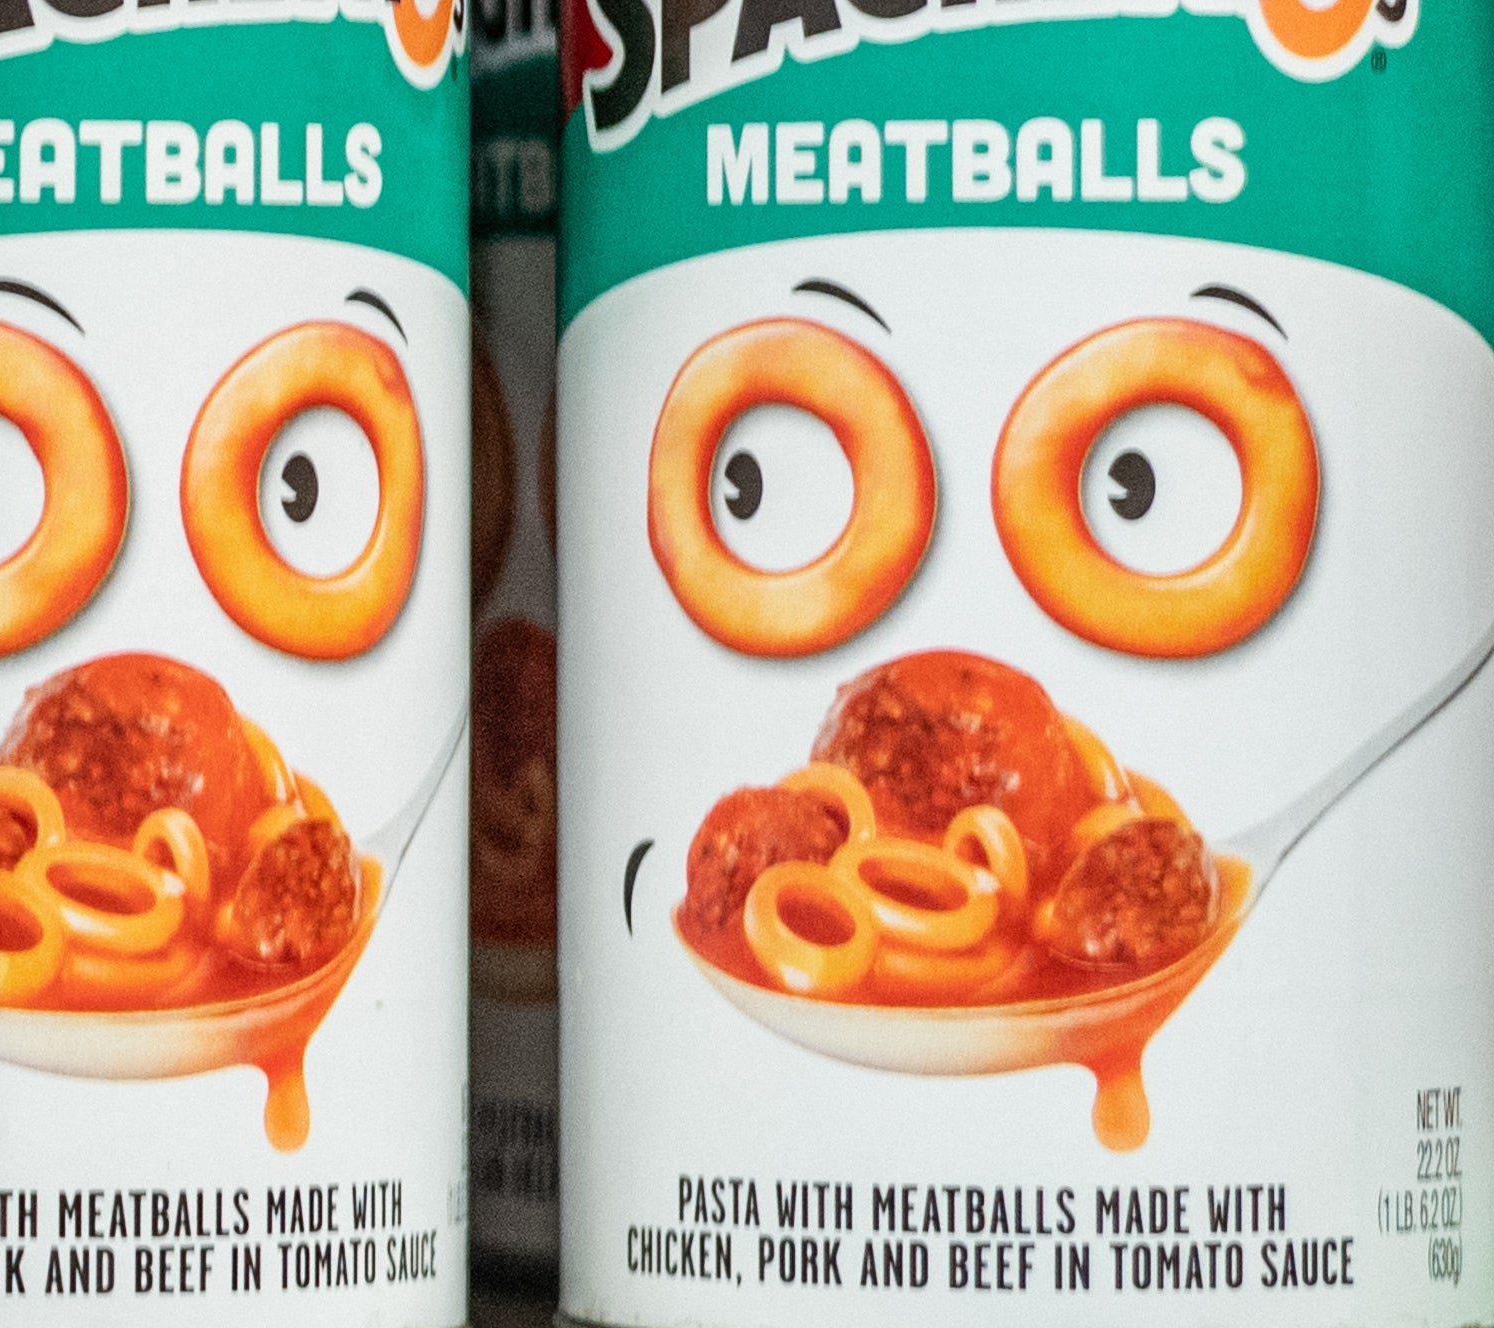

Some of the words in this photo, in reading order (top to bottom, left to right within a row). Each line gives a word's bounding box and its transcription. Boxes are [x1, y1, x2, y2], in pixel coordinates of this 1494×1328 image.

[707, 117, 1246, 204] MEATBALLS
[59, 1189, 249, 1238] MEATBALLS
[267, 1185, 338, 1235] MADE
[352, 1181, 402, 1230] WITH
[679, 1175, 760, 1227] PASTA
[776, 1181, 853, 1231] WITH
[873, 1185, 1075, 1235] MEATBALLS
[1096, 1187, 1189, 1235] MADE
[1208, 1185, 1285, 1233] WITH
[45, 1248, 115, 1294] AND
[135, 1246, 214, 1293] BEEF
[232, 1245, 261, 1292] IN
[278, 1239, 376, 1290] TOMATO
[387, 1230, 437, 1283] SAUCE
[627, 1225, 742, 1286] CHICKEN,
[759, 1236, 842, 1285] PORK
[860, 1240, 928, 1288] AND
[949, 1243, 1035, 1290] BEEF
[1055, 1244, 1090, 1290] IN
[1110, 1242, 1243, 1290] TOMATO
[1261, 1238, 1354, 1288] SAUCE
